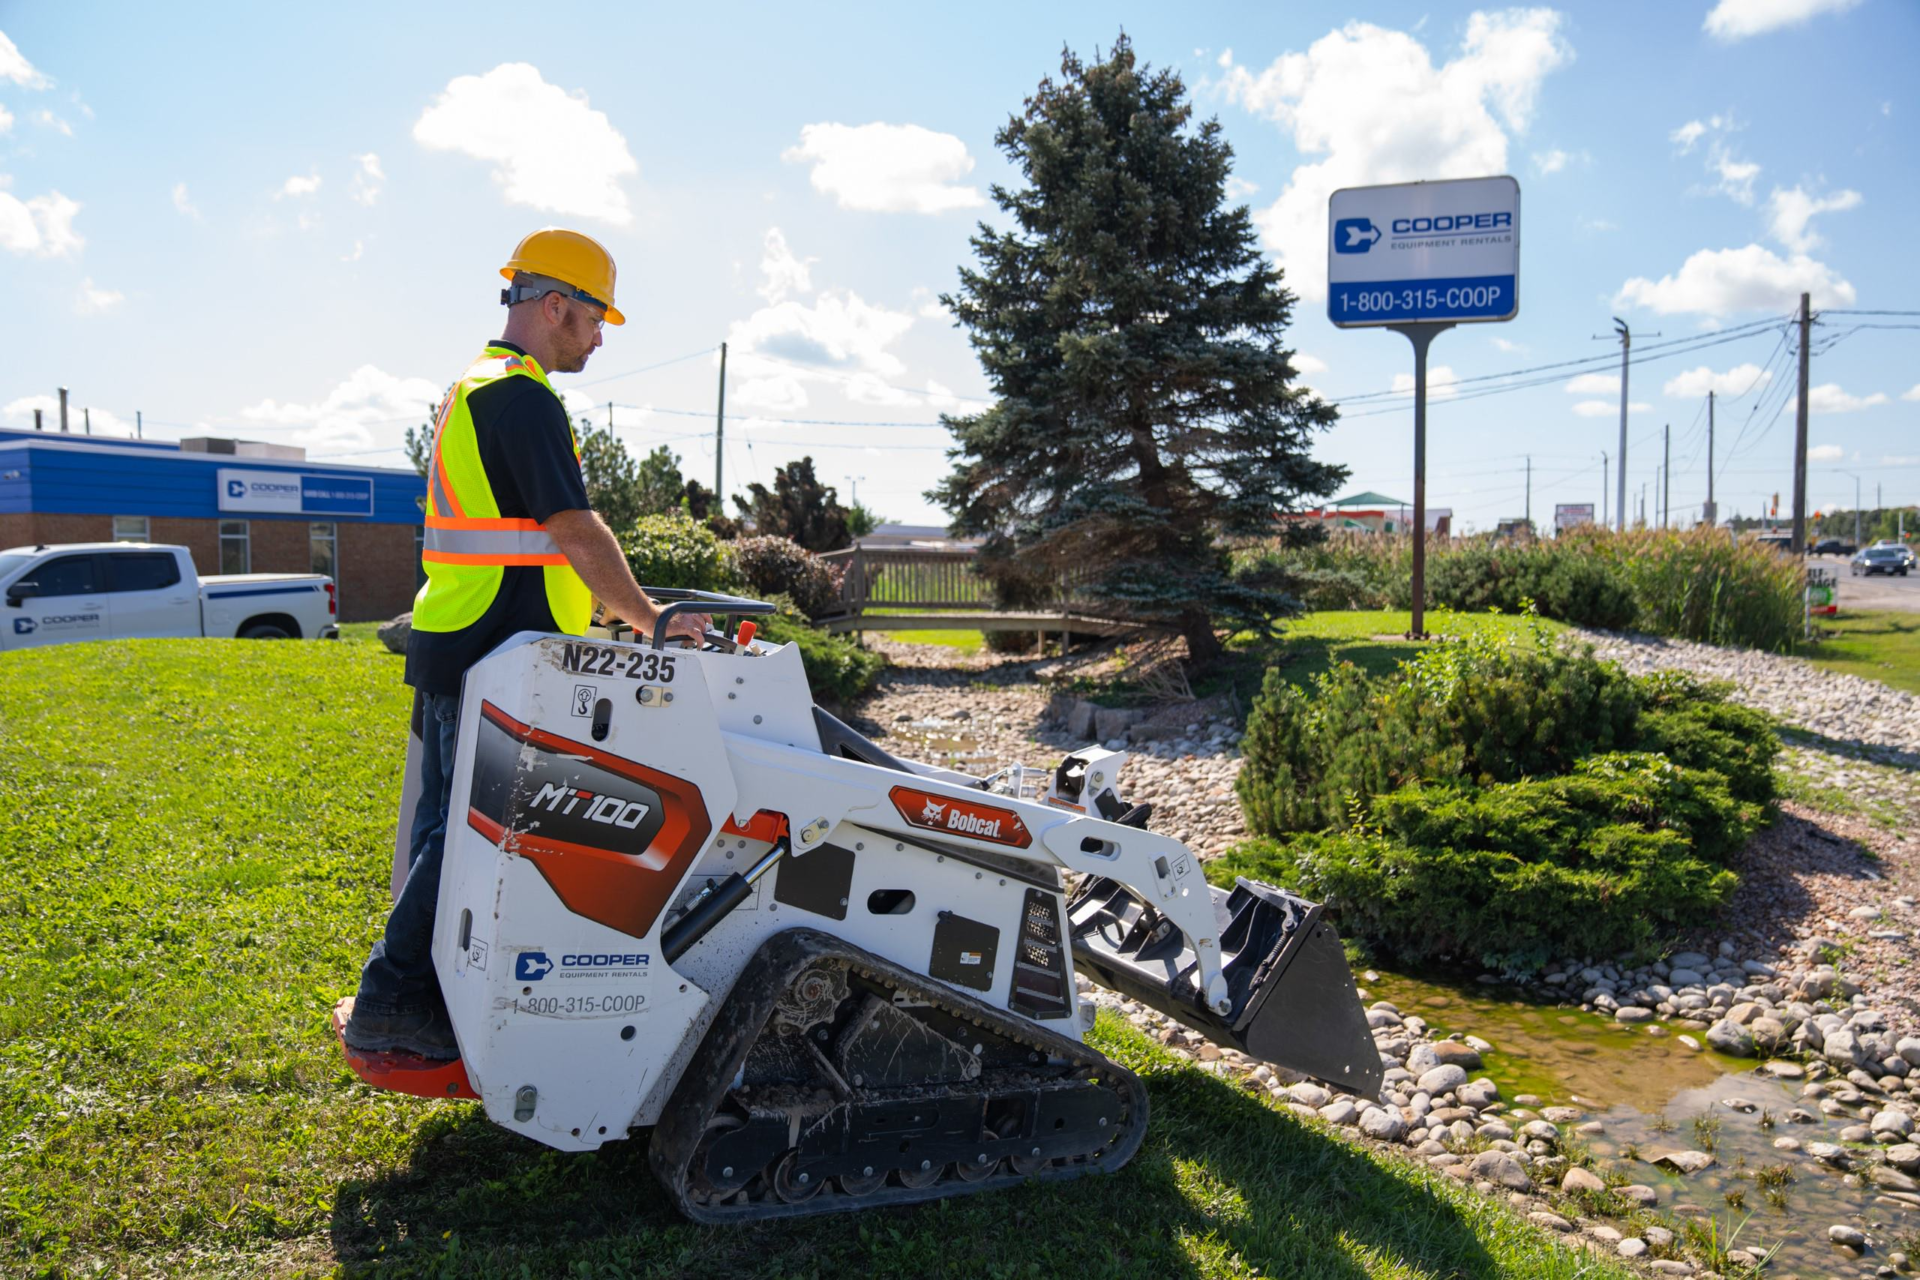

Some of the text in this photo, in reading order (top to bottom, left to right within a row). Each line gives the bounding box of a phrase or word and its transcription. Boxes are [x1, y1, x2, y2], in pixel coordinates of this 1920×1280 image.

[1392, 212, 1511, 234] COOPER
[1391, 235, 1511, 250] EQUIPMENT RENTALS
[1340, 286, 1501, 312] 1-800-315-COOP
[251, 483, 299, 492] COOPER
[43, 614, 99, 624] COOPER
[562, 643, 676, 683] N22-235
[529, 782, 650, 830] MT100
[947, 809, 1001, 838] Bobcat
[561, 954, 650, 966] COOPER
[559, 971, 609, 979] EQUIPMENT
[511, 995, 645, 1015] 1-800-315-COOP
